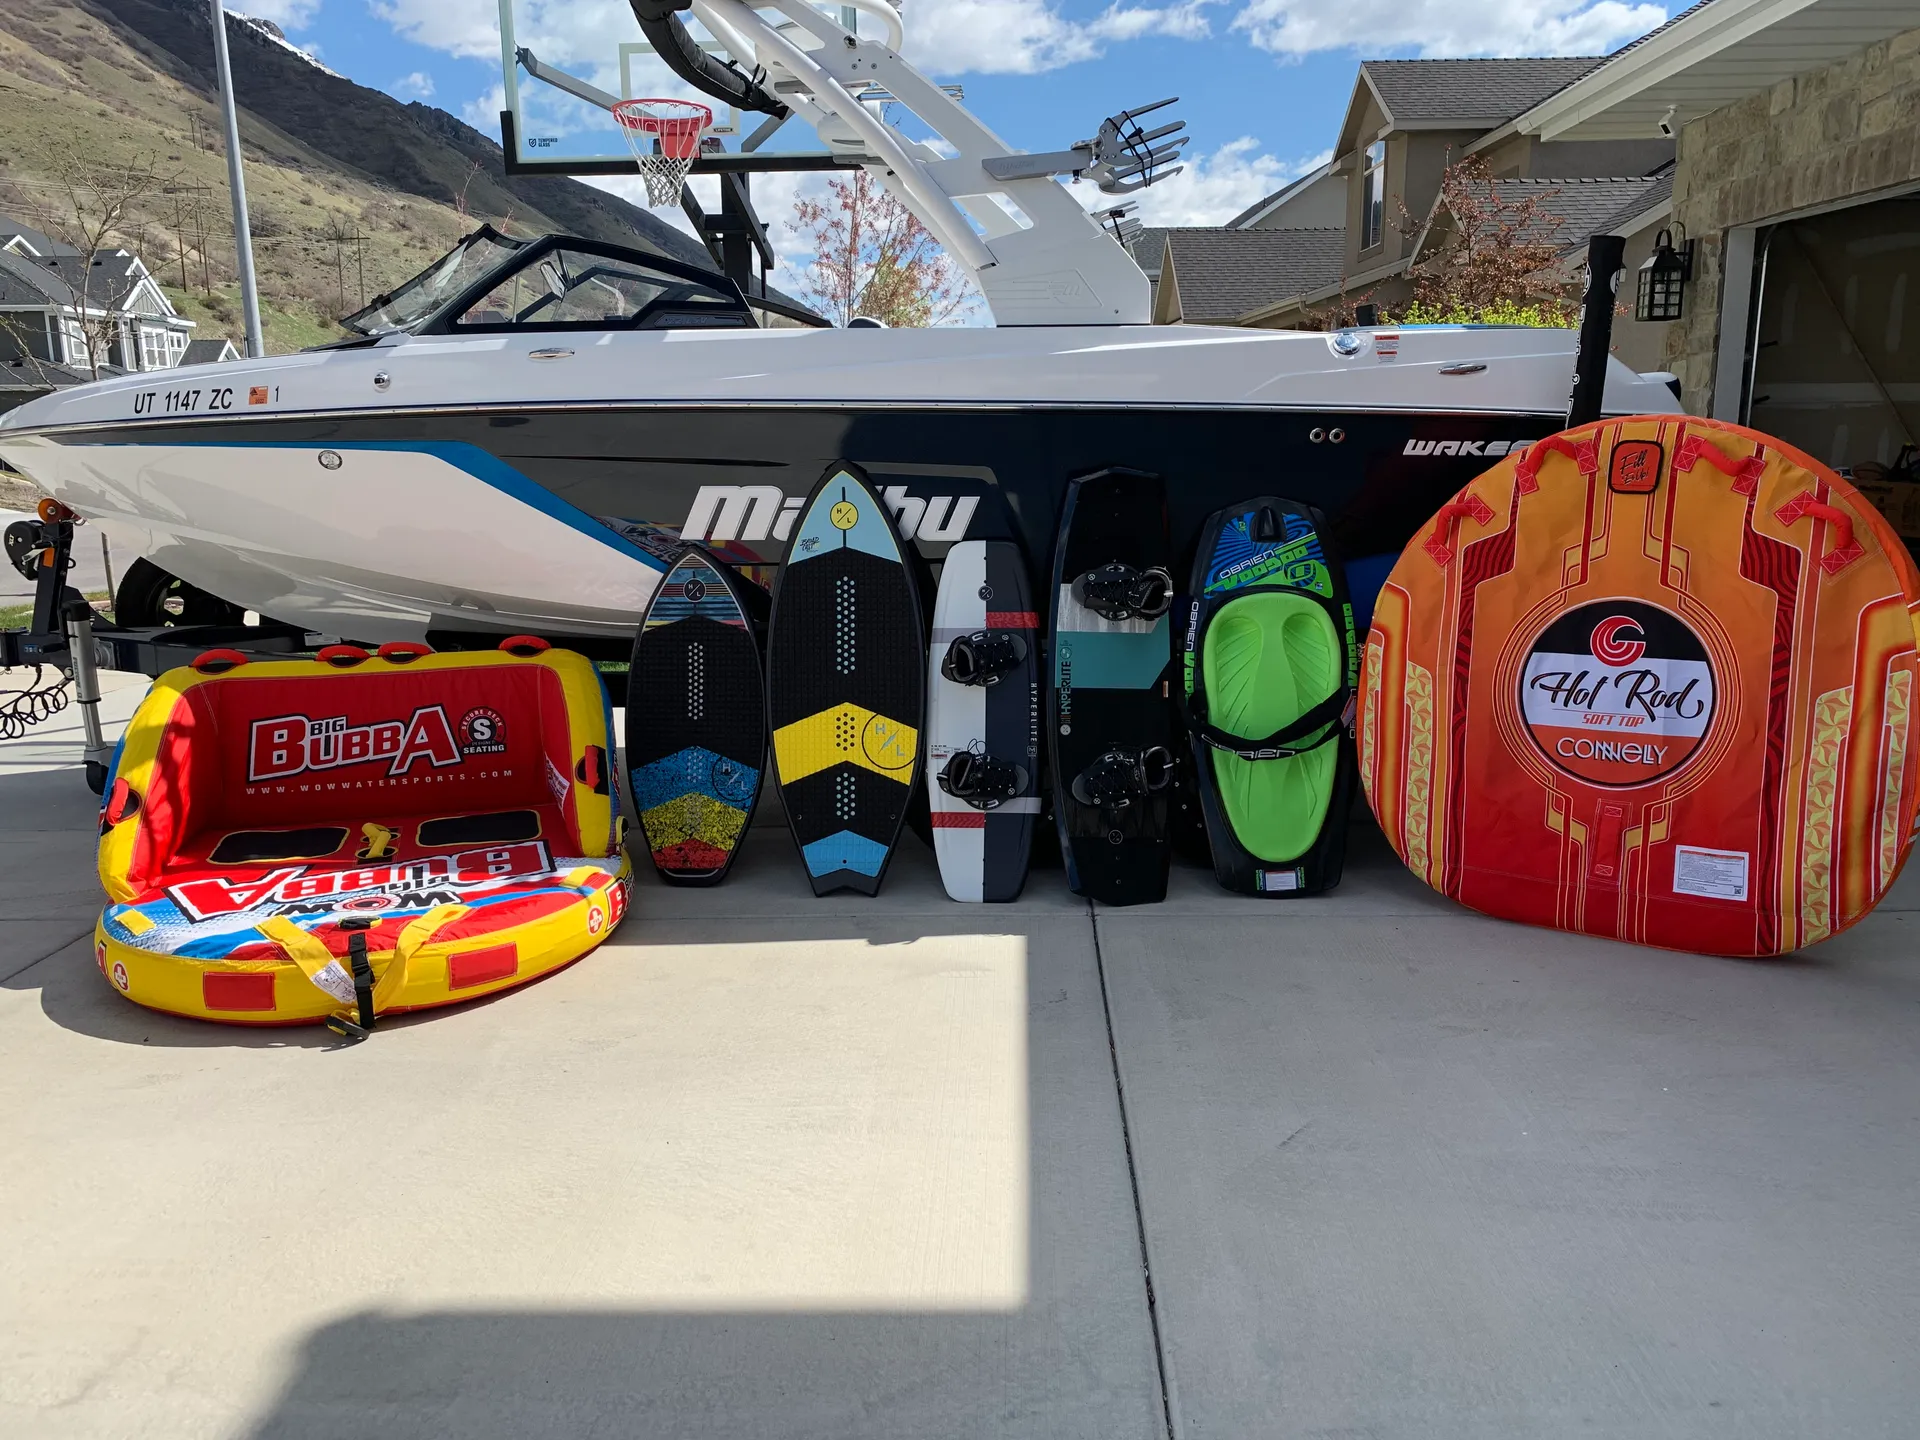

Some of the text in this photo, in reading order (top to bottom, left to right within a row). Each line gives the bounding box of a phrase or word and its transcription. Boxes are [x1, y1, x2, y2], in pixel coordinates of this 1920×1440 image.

[134, 392, 156, 414] UT
[165, 390, 201, 412] 1147
[209, 388, 233, 410] ZC
[1620, 449, 1648, 475] Fill
[1220, 549, 1275, 579] OBRIEN
[1186, 601, 1199, 652] OBRIEN
[1530, 669, 1704, 722] Hot Rod
[461, 709, 503, 730] SECURE DECK
[1030, 682, 1038, 742] HYPERLITE
[1582, 713, 1645, 728] SOFT TOP
[310, 717, 346, 736] BIG
[473, 718, 492, 740] S
[248, 704, 462, 783] BUBBA
[463, 744, 505, 754] SEATING
[1556, 737, 1668, 765] CONNELLY
[246, 770, 513, 795] WWW.WOWWATERSPORTS.COM
[160, 840, 556, 922] BUBBA
